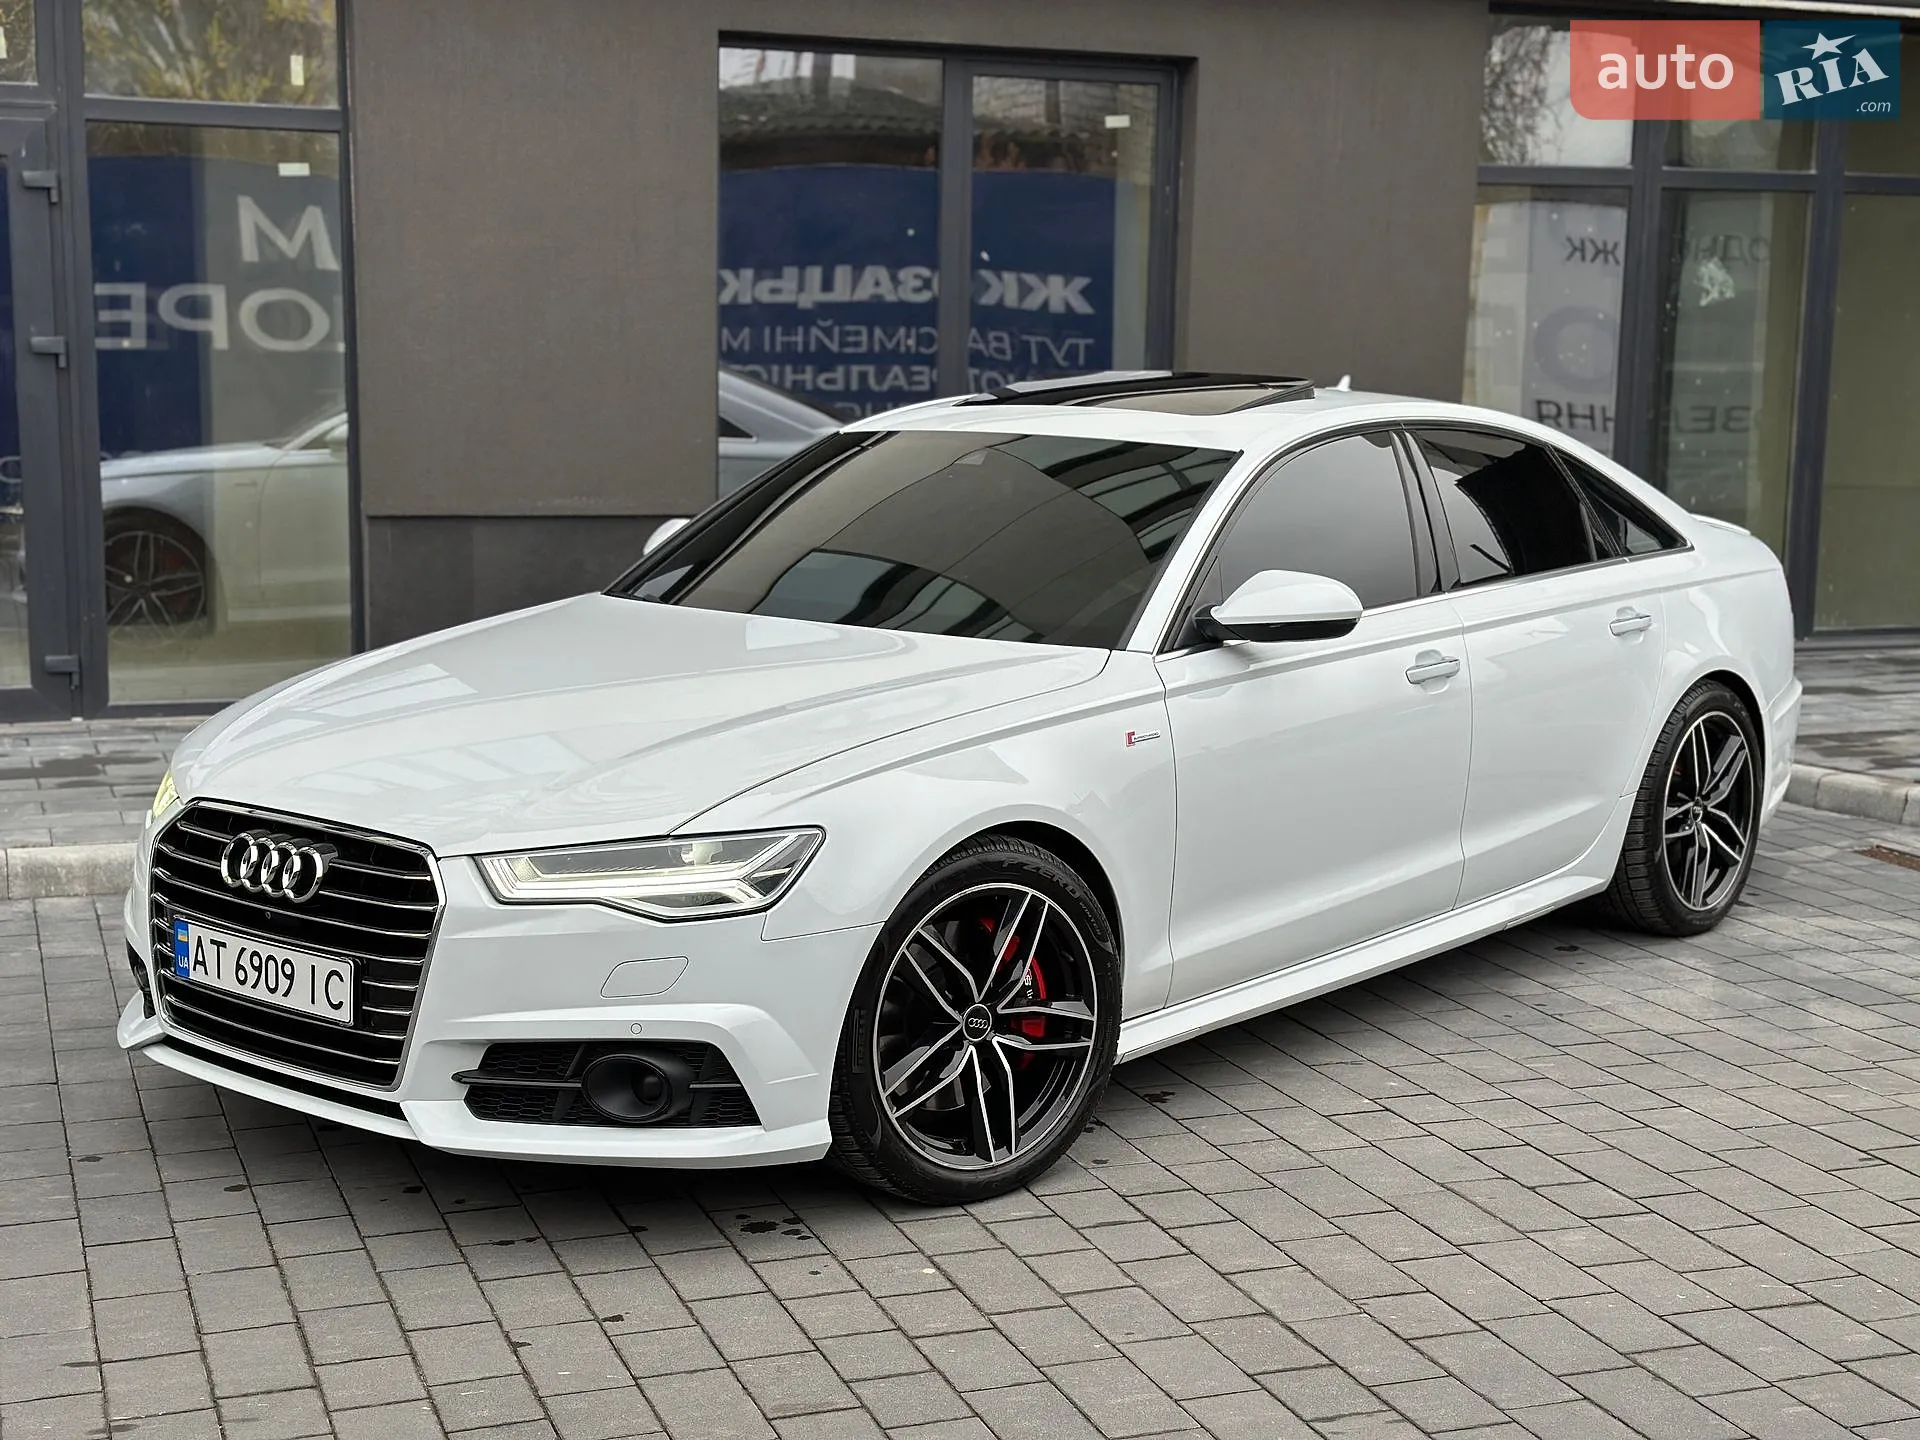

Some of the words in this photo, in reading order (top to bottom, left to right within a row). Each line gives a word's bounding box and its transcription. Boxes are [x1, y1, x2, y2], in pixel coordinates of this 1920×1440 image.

[178, 955, 189, 970] UA
[193, 935, 227, 980] AT
[235, 946, 296, 998] 6909
[310, 964, 345, 1011] IC
